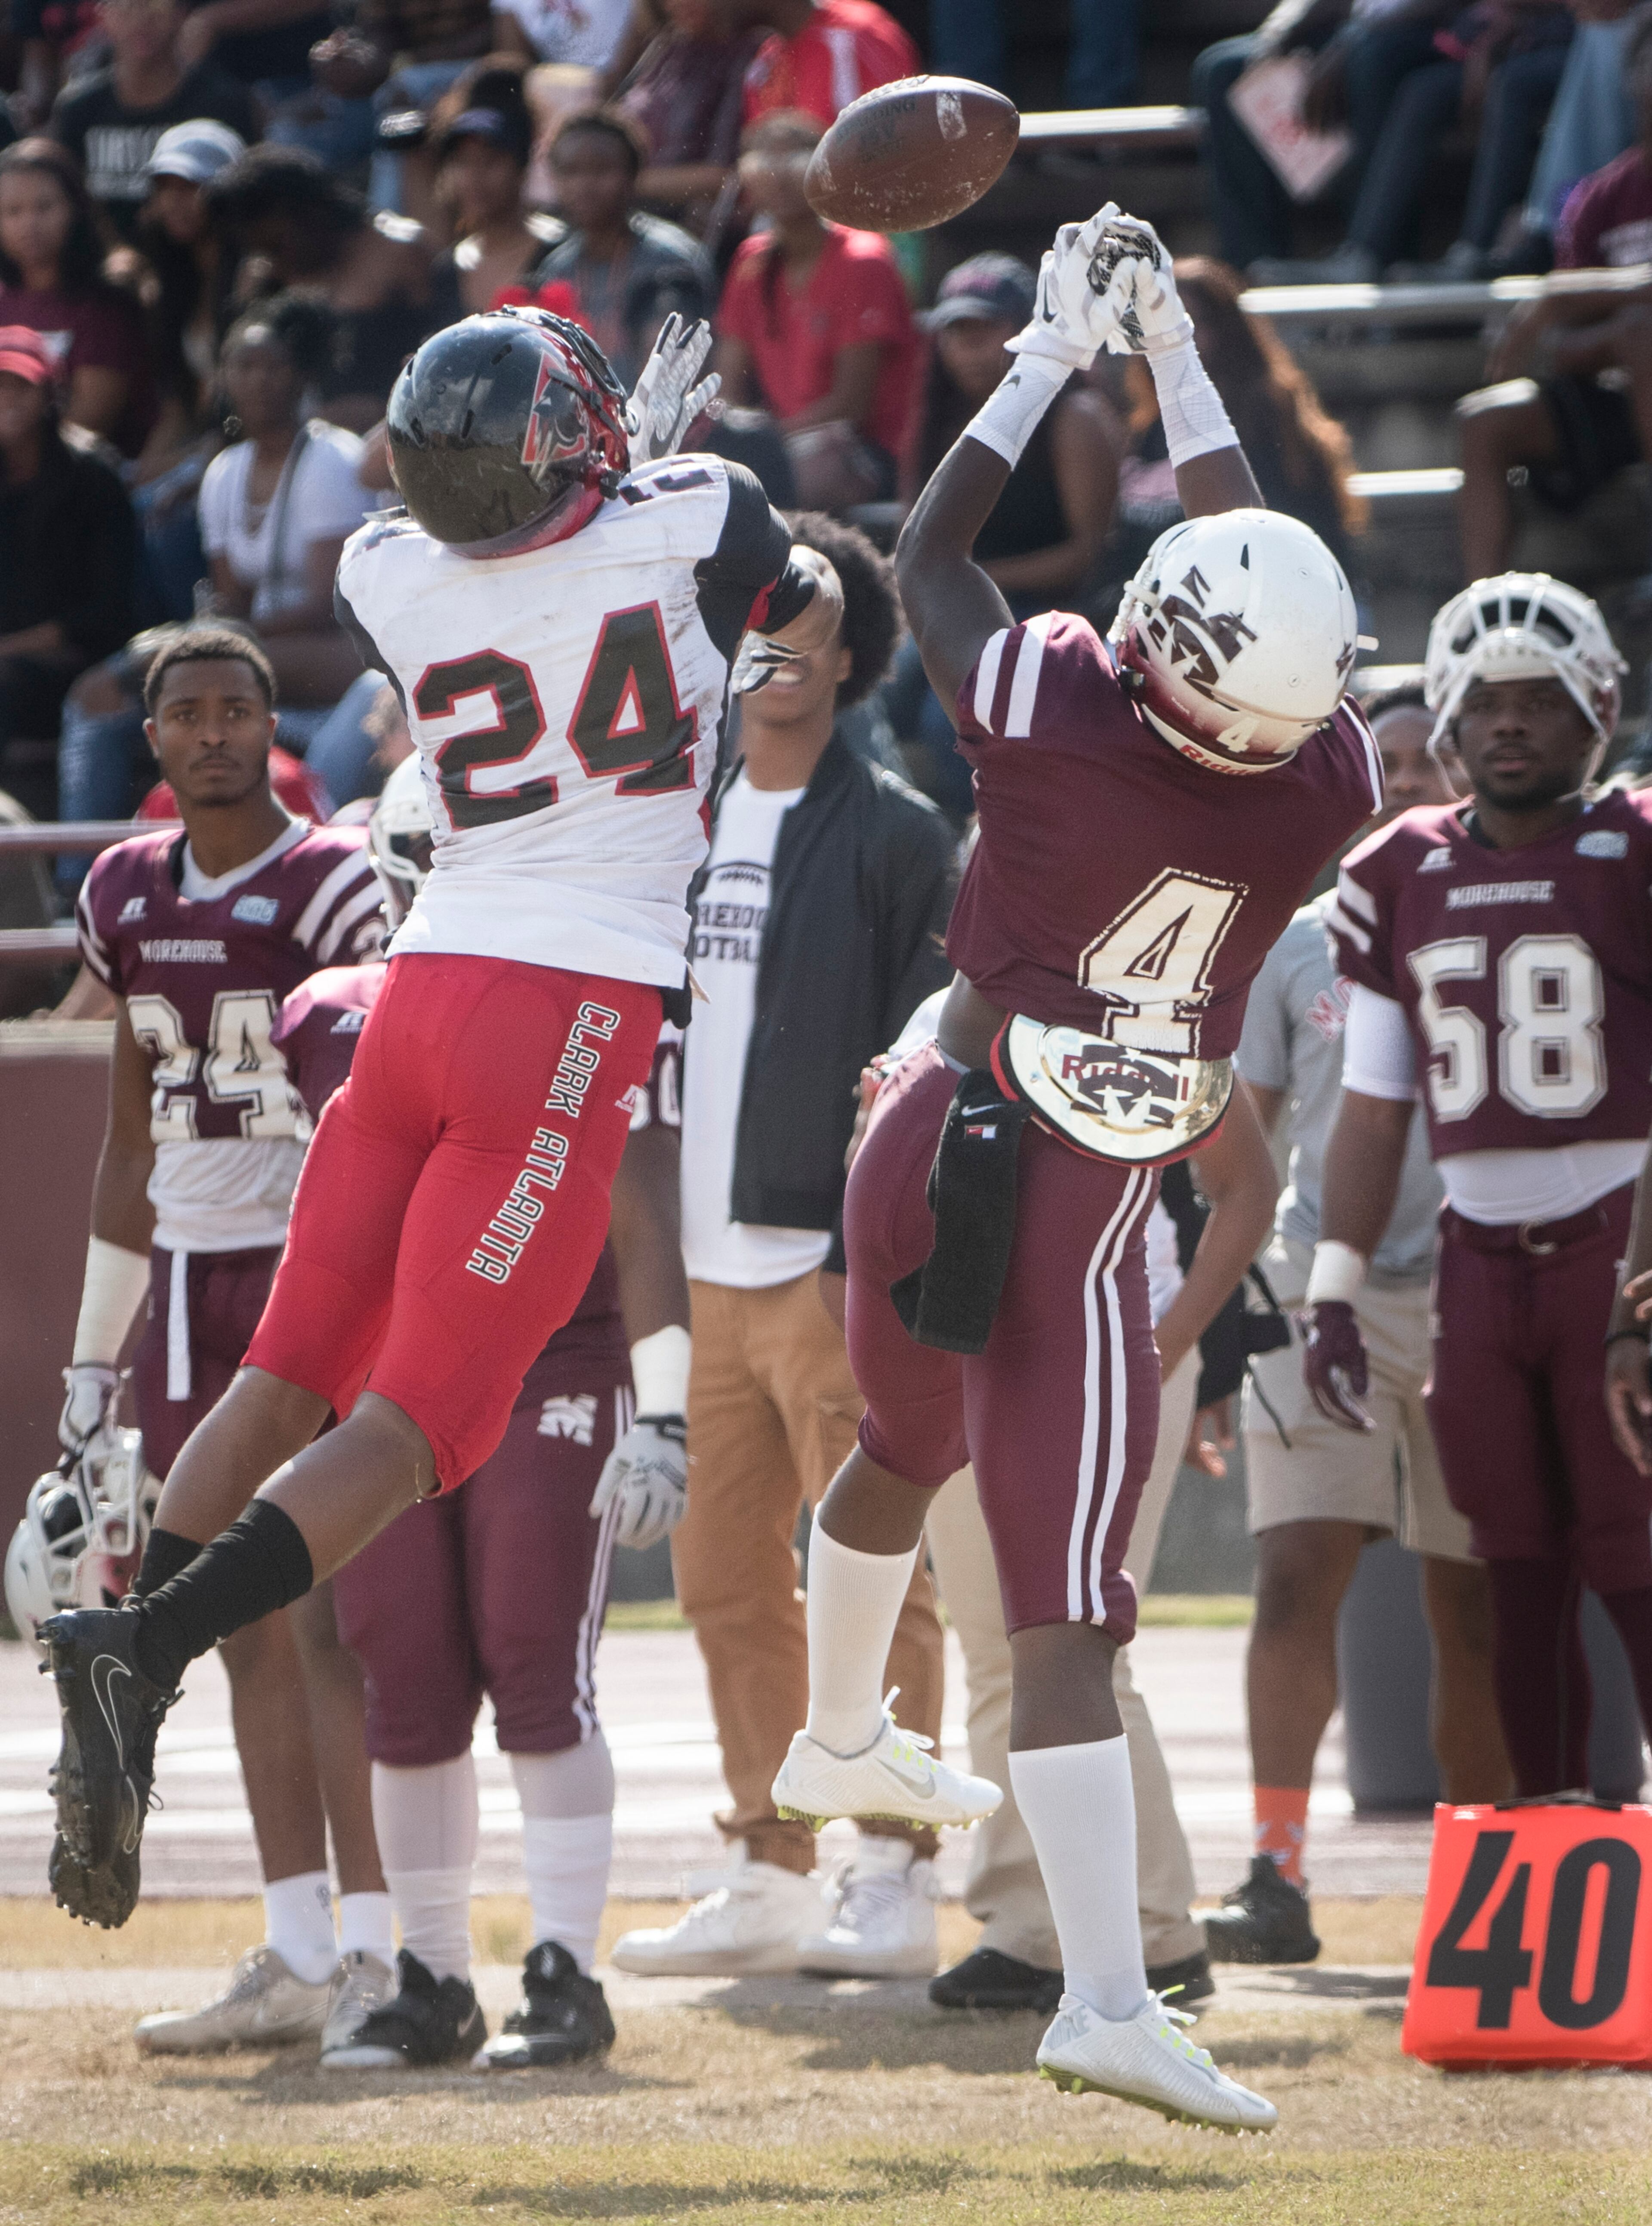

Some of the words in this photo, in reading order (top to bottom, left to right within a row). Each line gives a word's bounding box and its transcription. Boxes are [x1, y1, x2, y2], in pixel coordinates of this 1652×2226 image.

[412, 600, 699, 831] 24
[1216, 716, 1261, 753] 4
[138, 939, 228, 963] MOREHOUSE
[1078, 867, 1249, 1059] 4
[1406, 934, 1608, 1124] 58
[126, 989, 314, 1143] 24
[545, 1001, 620, 1119] CLARK
[465, 1127, 569, 1284] ATLANTA
[1425, 1830, 1642, 2030] 40
